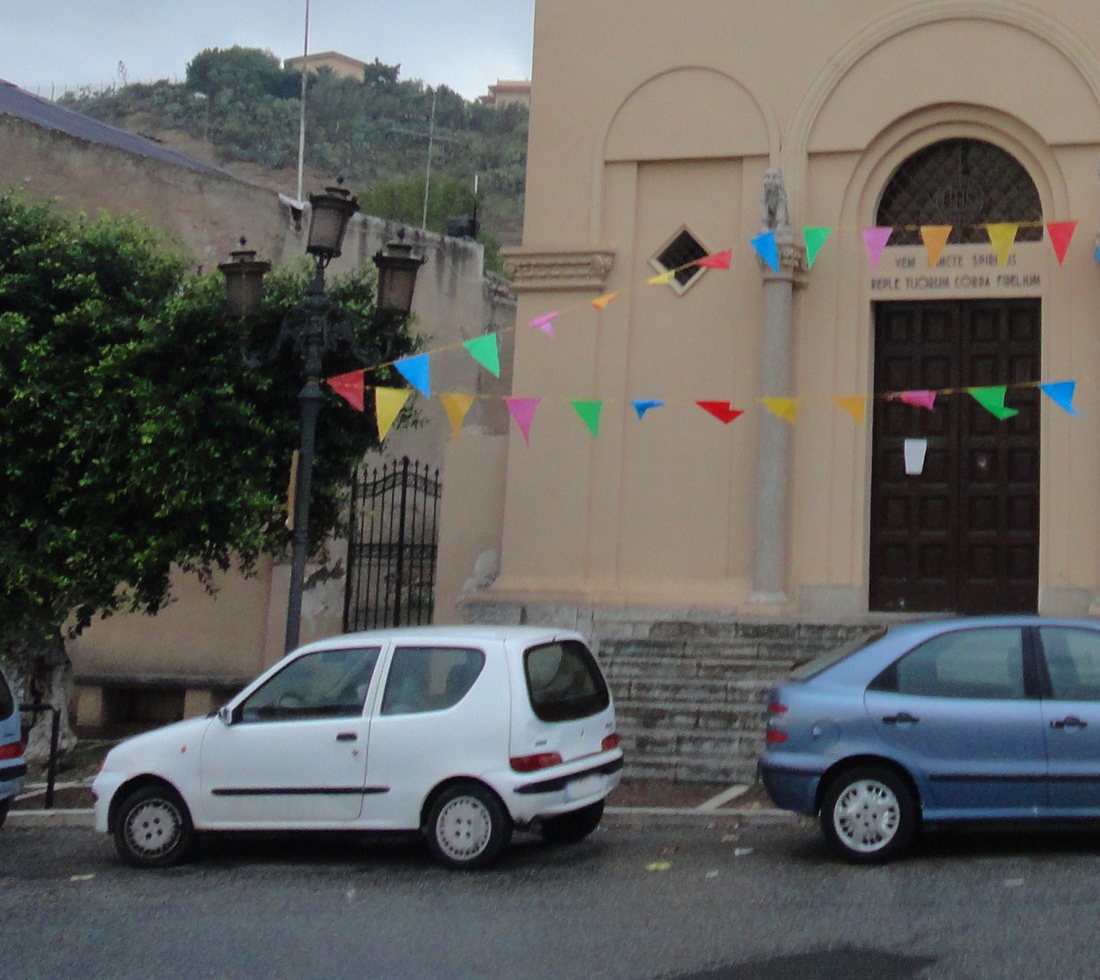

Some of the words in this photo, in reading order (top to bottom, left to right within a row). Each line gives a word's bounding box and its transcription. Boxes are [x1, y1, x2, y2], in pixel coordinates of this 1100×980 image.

[895, 256, 916, 268] VENI
[927, 255, 963, 268] ANCTE
[972, 253, 1017, 267] SPIRIUS
[871, 276, 900, 290] REPLE
[906, 275, 950, 289] TUORUM
[954, 274, 990, 288] CORDA
